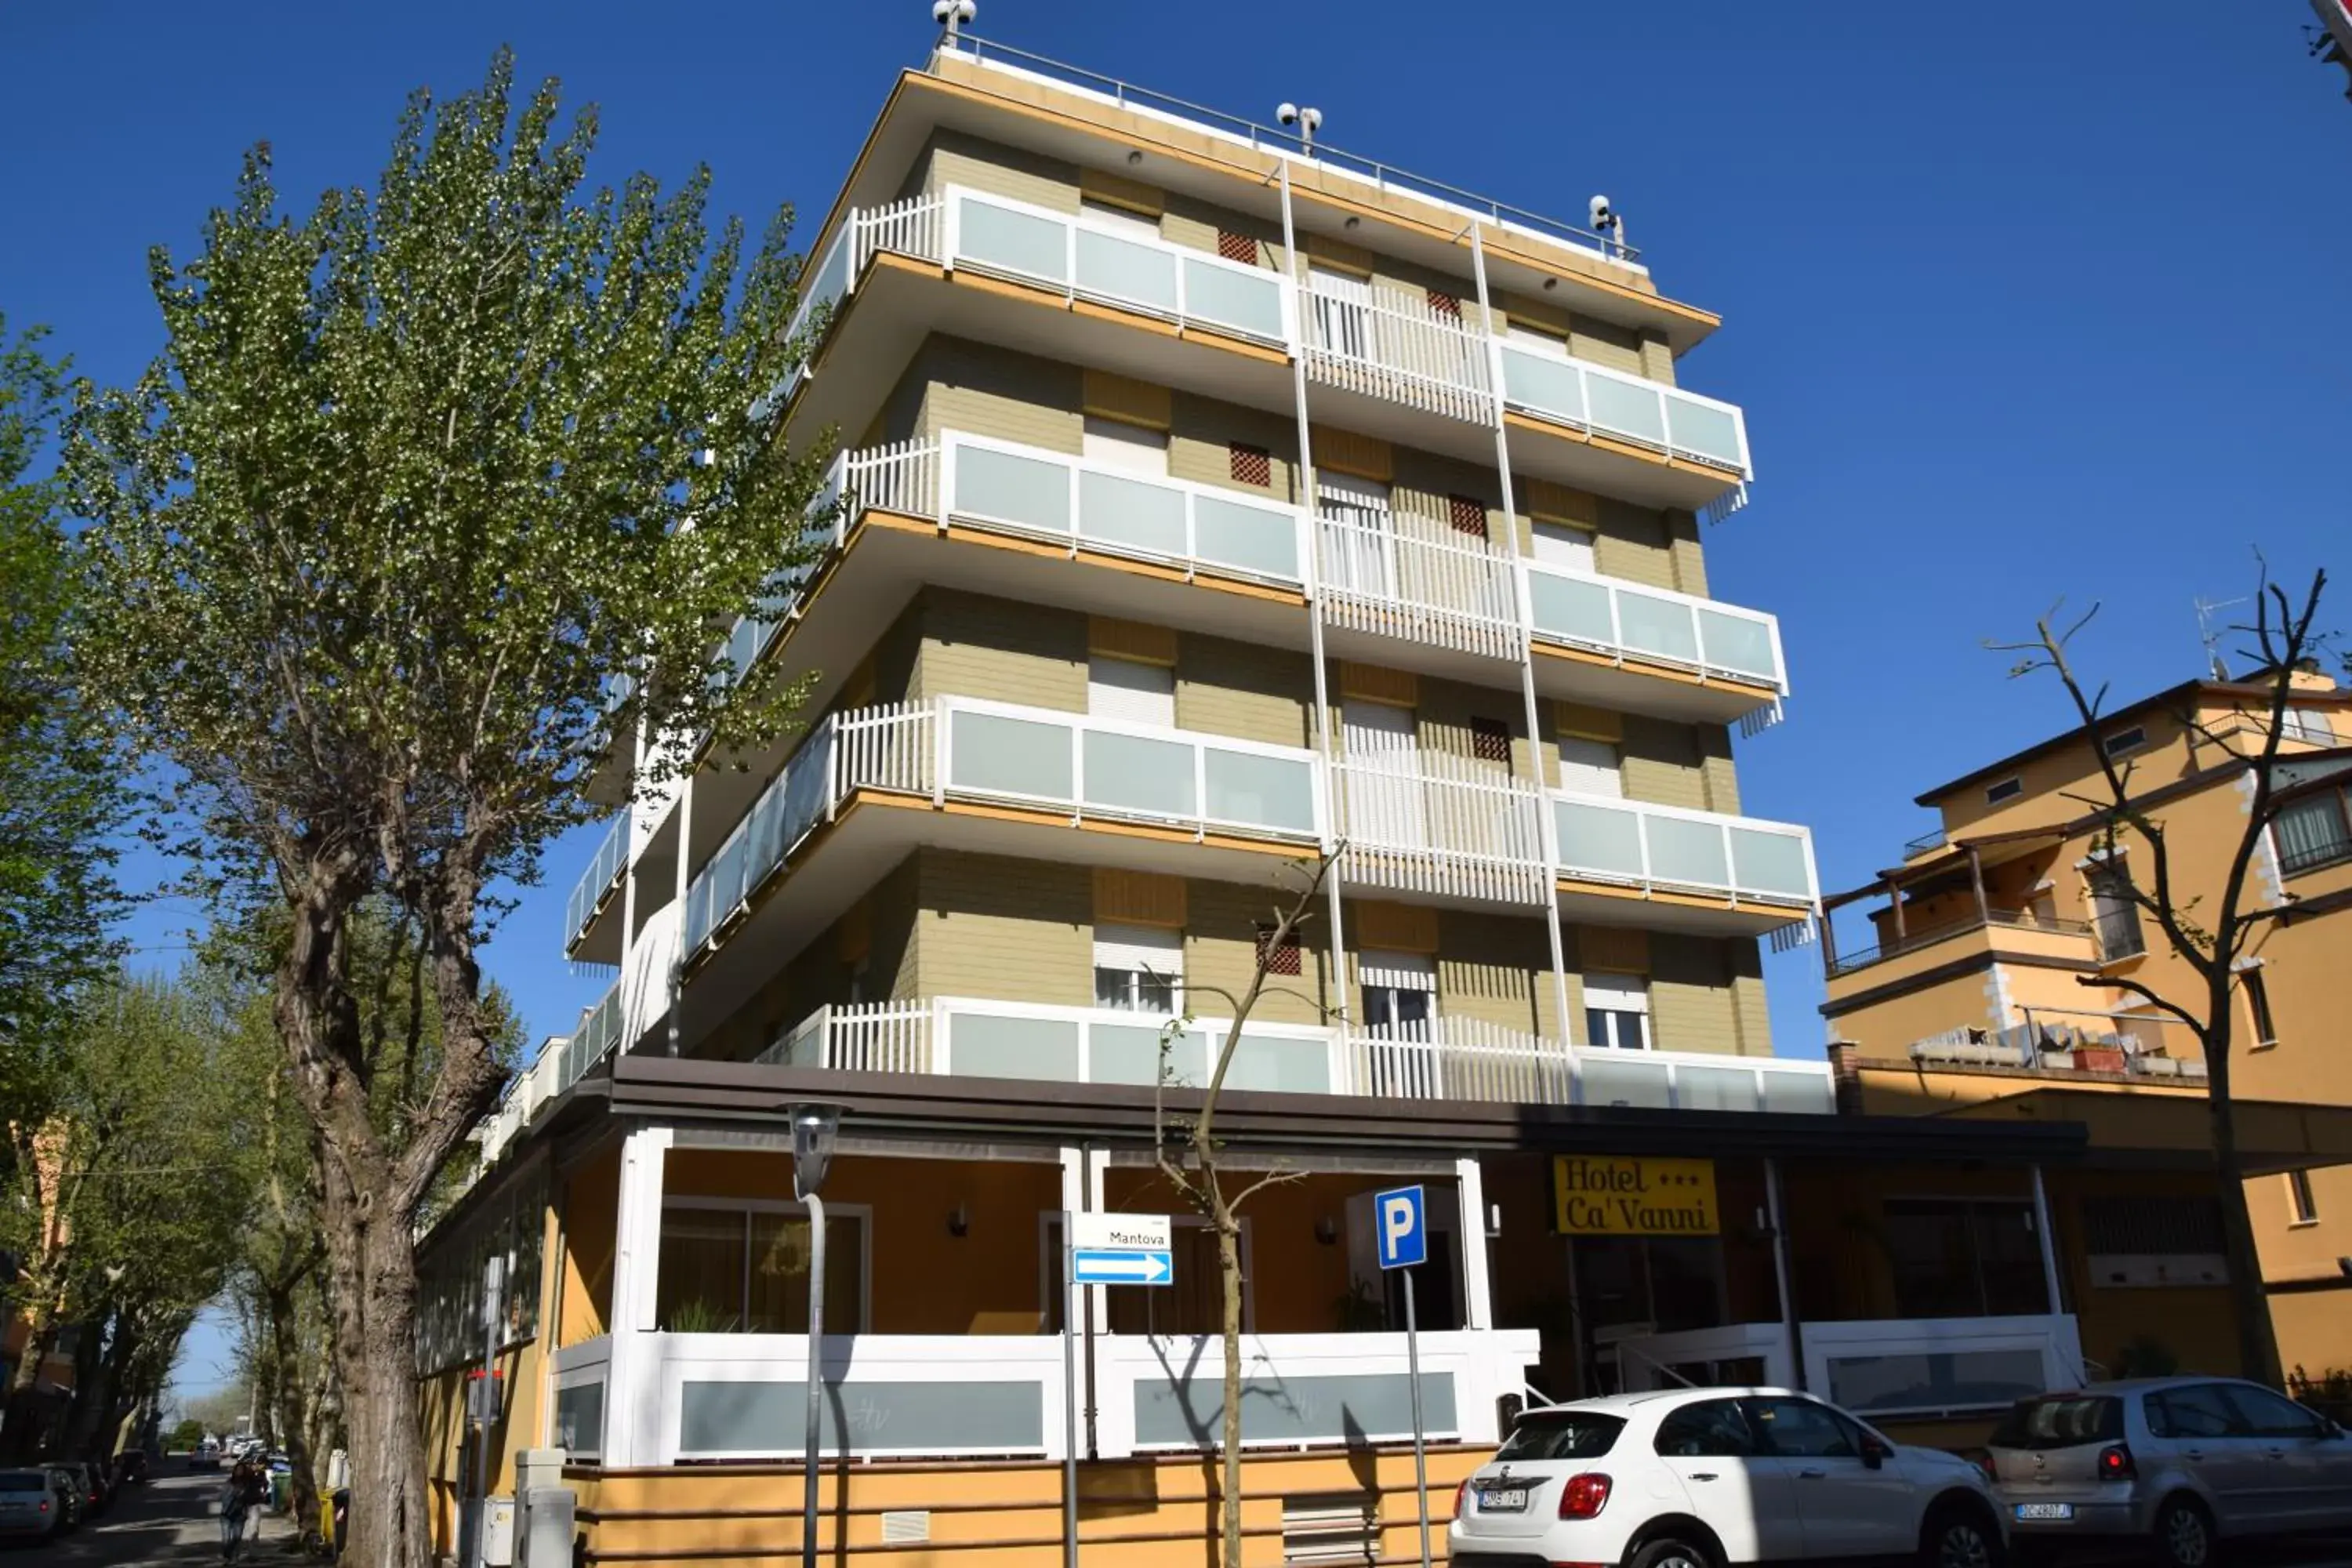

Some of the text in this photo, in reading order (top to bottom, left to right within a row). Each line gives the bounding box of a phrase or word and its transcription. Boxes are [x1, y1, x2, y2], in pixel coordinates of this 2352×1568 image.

[1565, 1159, 1650, 1192] Hotel
[1384, 1197, 1414, 1260] P
[1566, 1196, 1710, 1230] Ca' Vanni
[1110, 1232, 1164, 1245] Mantova
